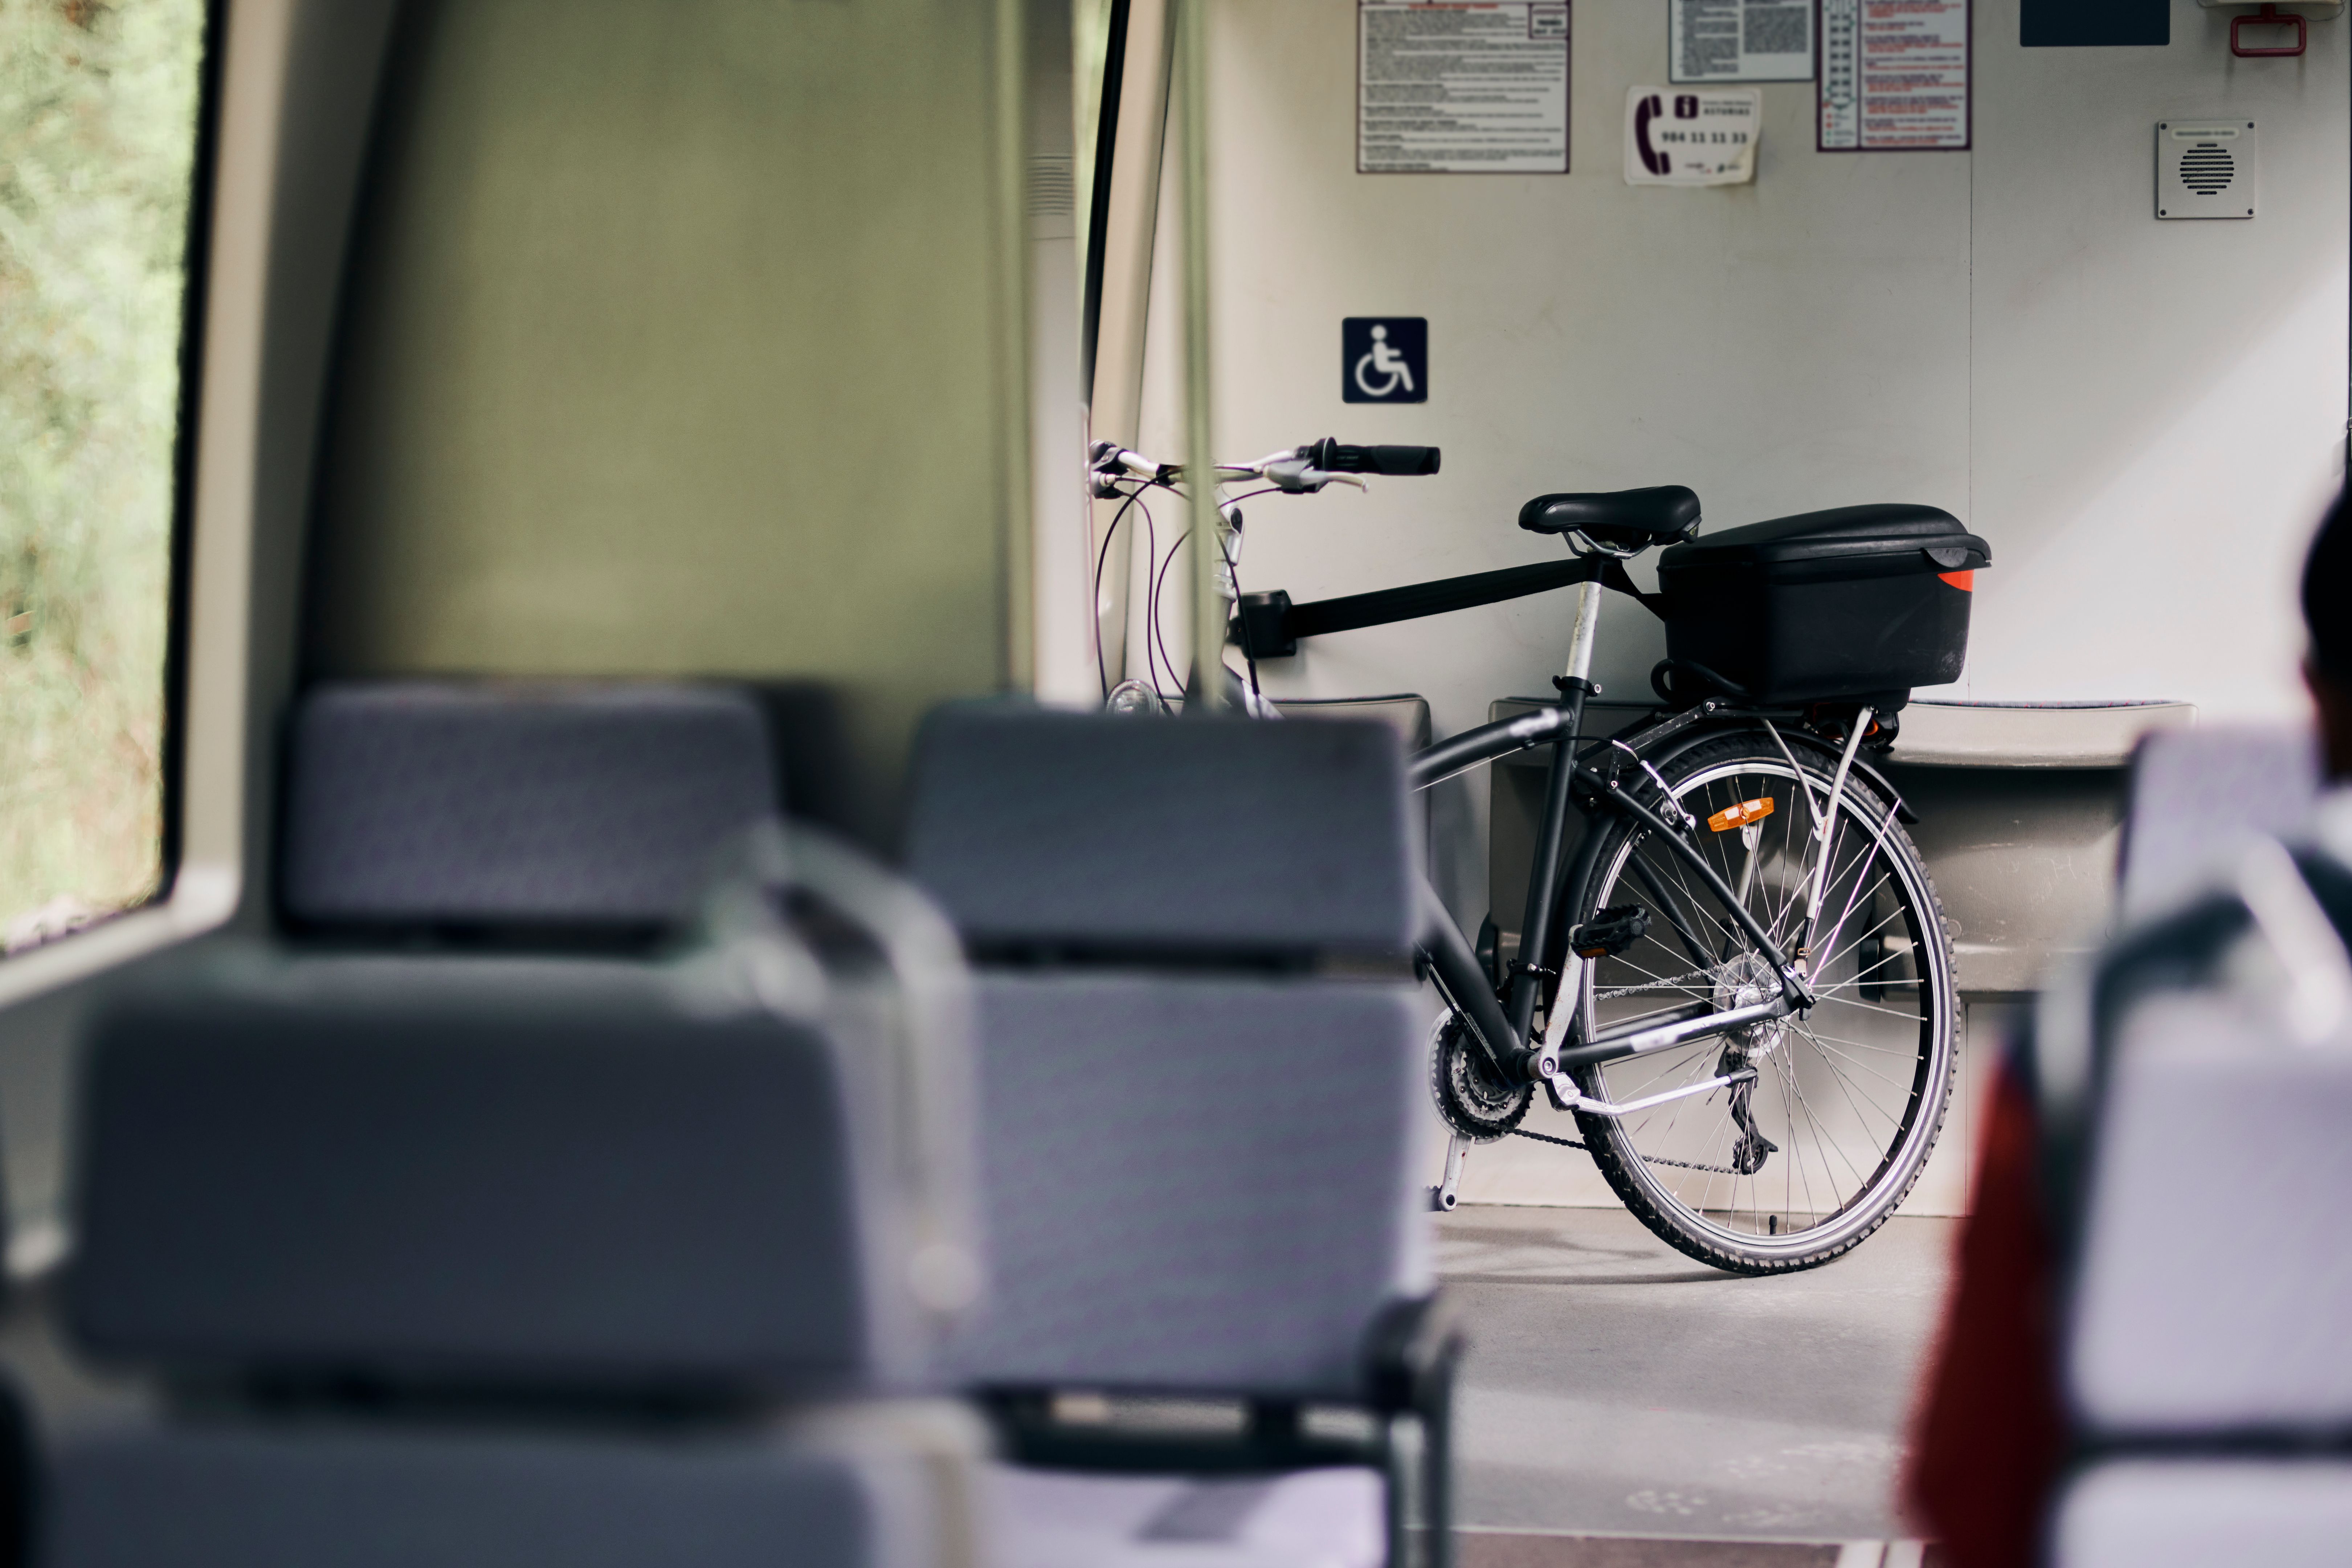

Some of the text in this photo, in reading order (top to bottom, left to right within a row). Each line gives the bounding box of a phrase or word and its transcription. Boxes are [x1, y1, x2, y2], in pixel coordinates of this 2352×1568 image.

[1661, 131, 1747, 143] 984 11 11 33
